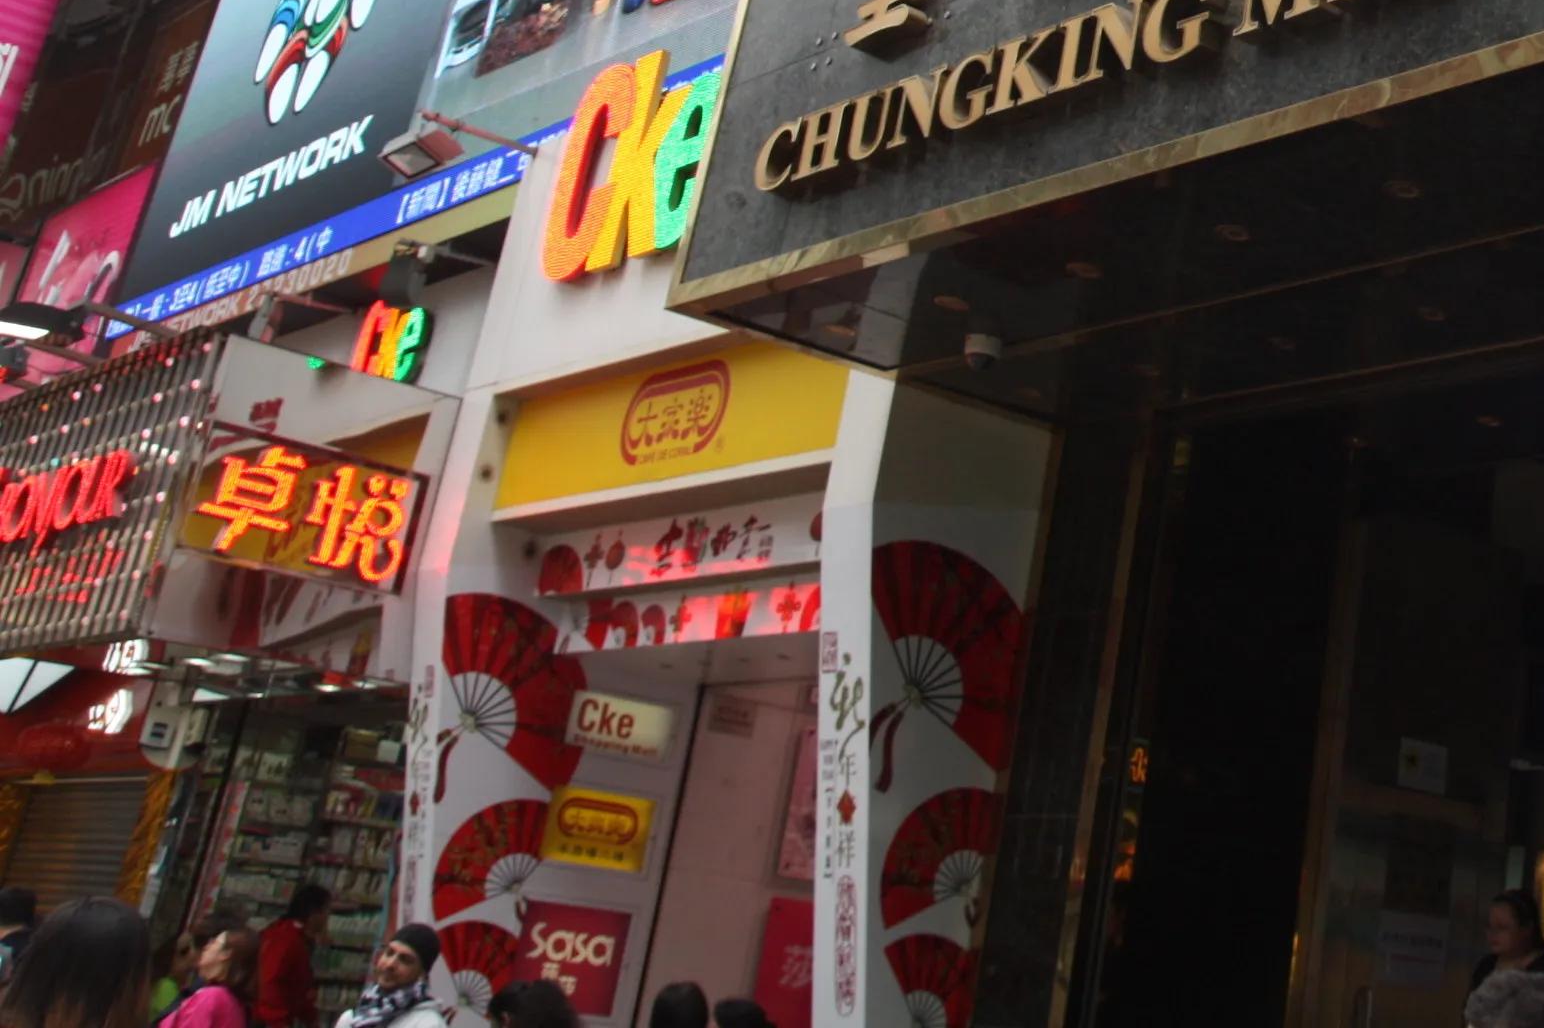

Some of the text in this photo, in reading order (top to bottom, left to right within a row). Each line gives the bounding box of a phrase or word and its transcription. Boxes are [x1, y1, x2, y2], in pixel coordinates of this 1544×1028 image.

[169, 115, 375, 239] JM NETWORK
[541, 49, 718, 280] Cke
[576, 697, 635, 740] Cke
